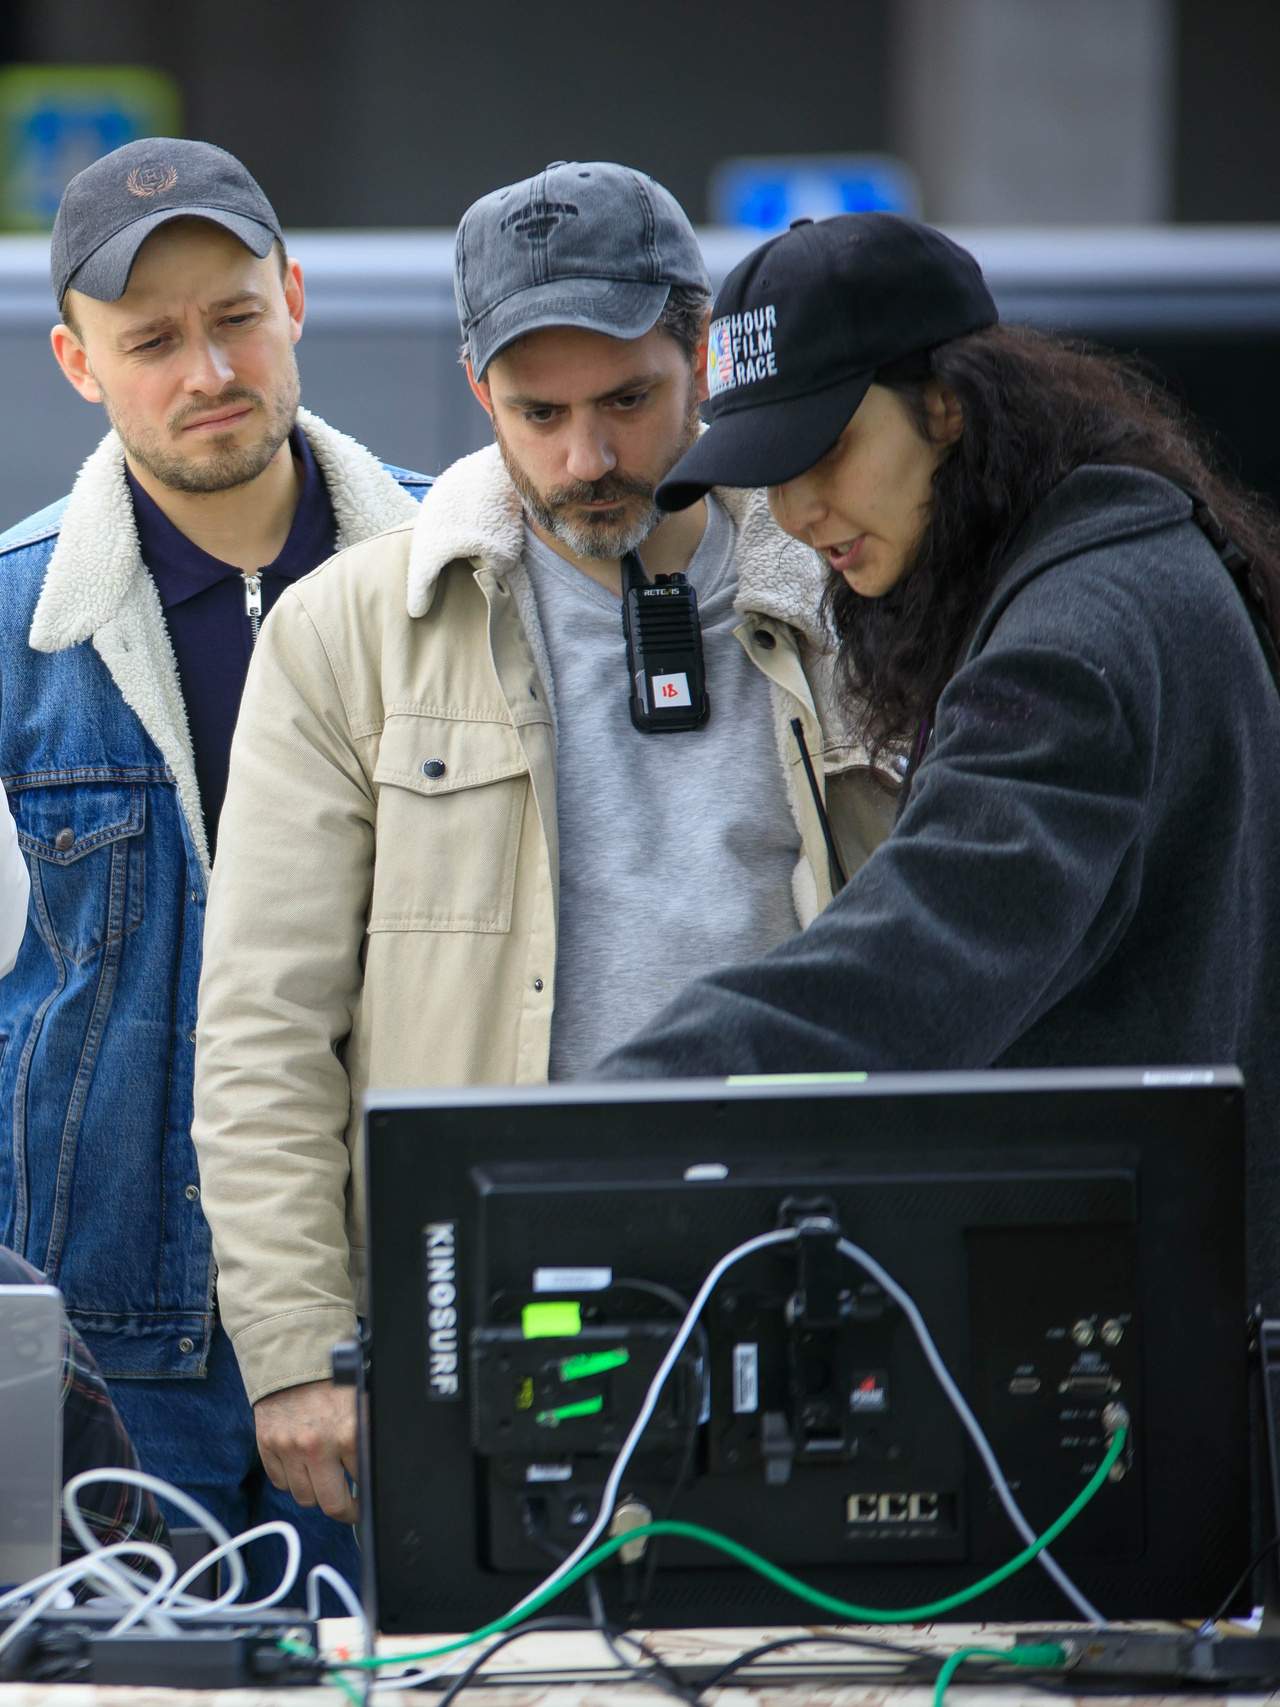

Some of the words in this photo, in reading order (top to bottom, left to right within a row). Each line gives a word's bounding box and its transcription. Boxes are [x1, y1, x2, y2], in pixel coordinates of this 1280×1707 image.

[731, 304, 777, 338] HOUR
[732, 328, 773, 362] FILM
[735, 351, 778, 386] RACE
[662, 683, 678, 698] 18
[423, 1222, 459, 1396] KINOSURF
